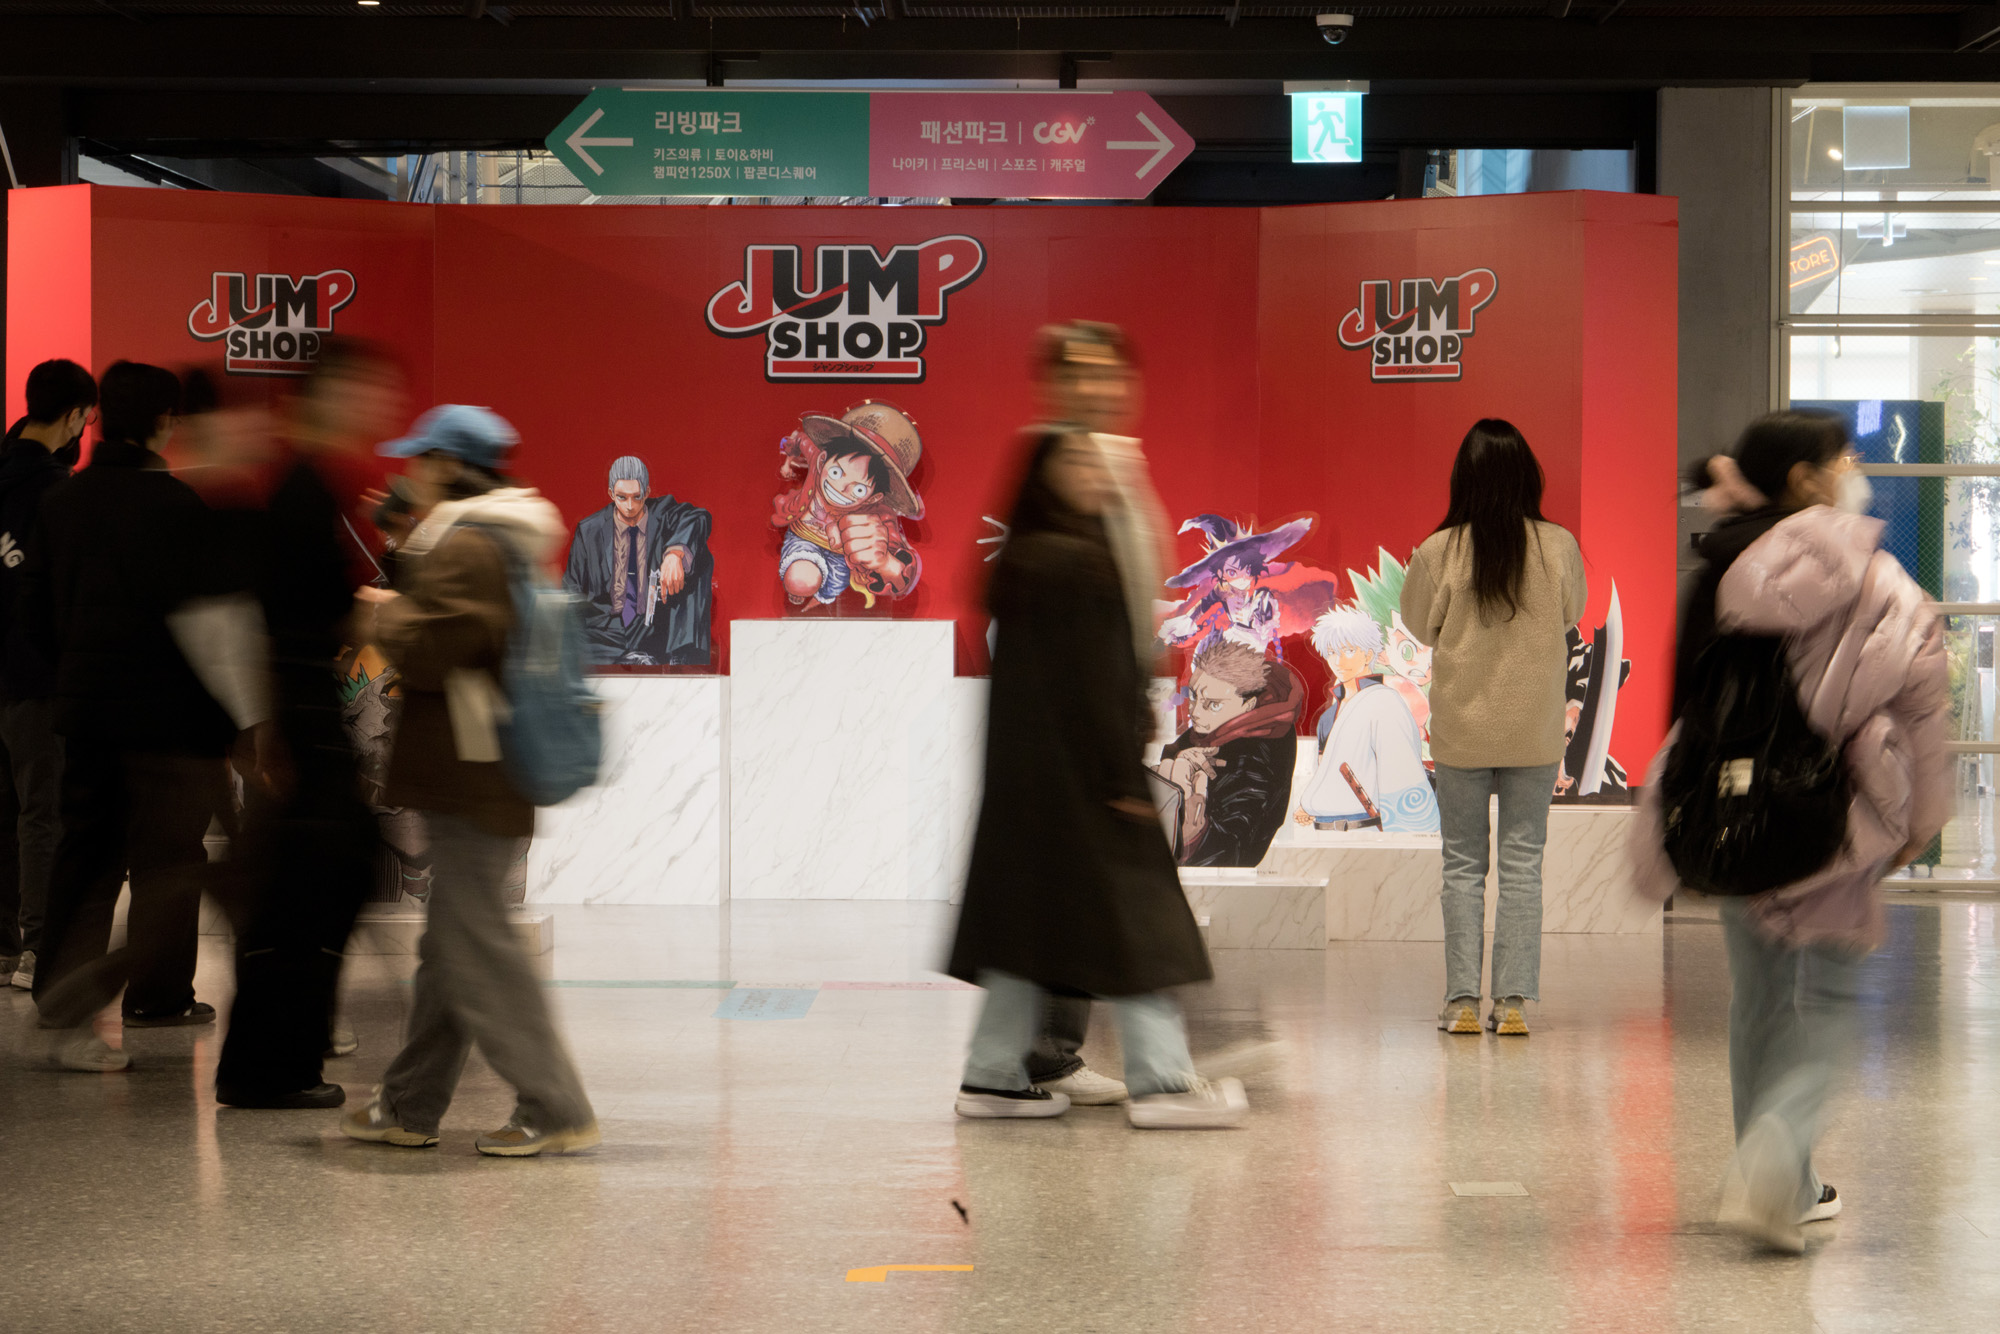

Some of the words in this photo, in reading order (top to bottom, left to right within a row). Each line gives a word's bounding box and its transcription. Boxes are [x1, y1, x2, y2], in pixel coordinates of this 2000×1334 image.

[654, 111, 743, 135] 리빙파크
[920, 120, 1008, 145] 패션파크
[1033, 121, 1087, 144] CGV
[653, 148, 702, 162] 키즈의류
[714, 148, 774, 162] 토이&하비
[892, 157, 928, 171] 나이키
[941, 157, 989, 171] 프리스비
[1001, 158, 1038, 171] 스포츠
[1049, 158, 1086, 172] 캐주얼
[653, 166, 731, 180] 챔피언1250X
[743, 166, 817, 180] 팝콘디스퀘어
[706, 236, 984, 334] JUMP
[189, 270, 356, 338] JUMP
[1339, 269, 1497, 346] JUMP
[228, 331, 319, 361] SHOP
[771, 321, 920, 359] SHOP
[1374, 335, 1460, 365] SHOP
